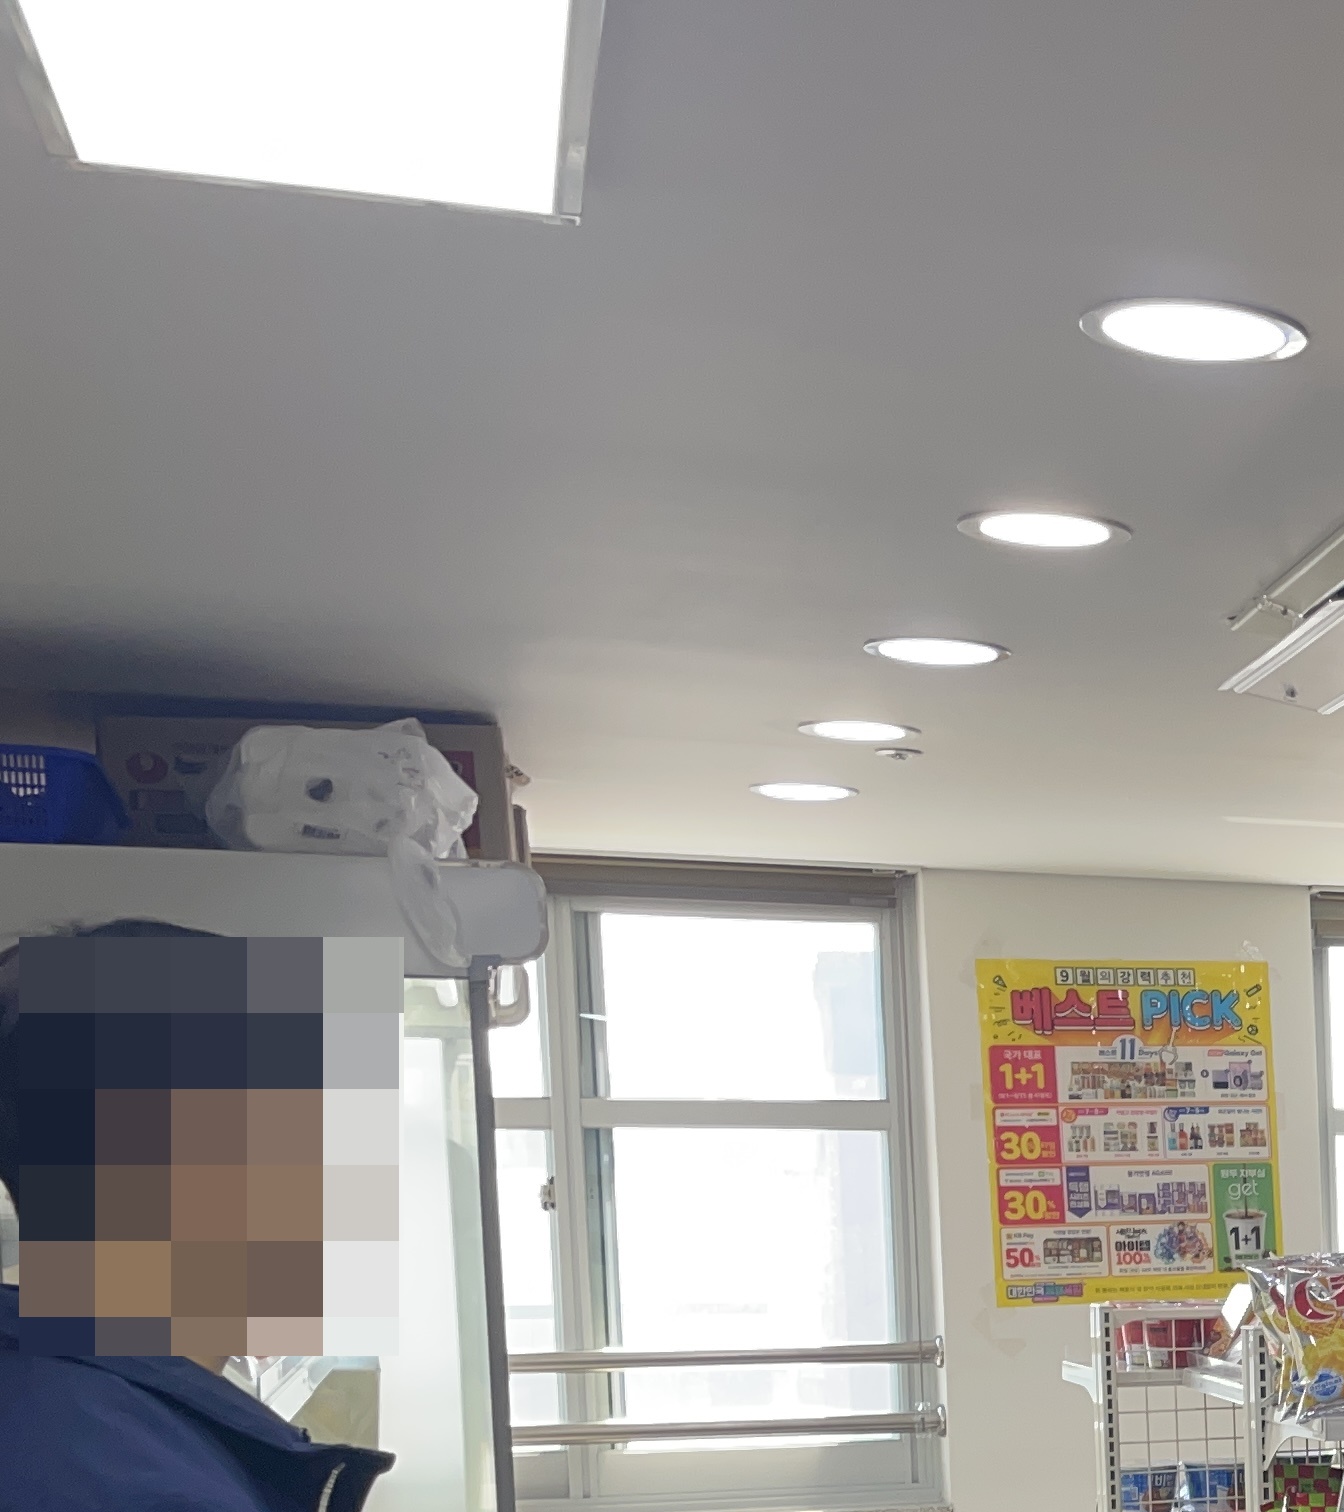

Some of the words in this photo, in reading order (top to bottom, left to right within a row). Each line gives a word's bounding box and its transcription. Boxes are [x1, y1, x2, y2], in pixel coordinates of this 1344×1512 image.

[1010, 986, 1136, 1035] 베스트
[1140, 989, 1242, 1031] PICK
[1119, 1037, 1136, 1060] 11
[998, 1062, 1046, 1090] 1+1
[1000, 1131, 1043, 1160] 30
[1228, 1179, 1260, 1200] get
[1229, 1226, 1261, 1250] 1+1
